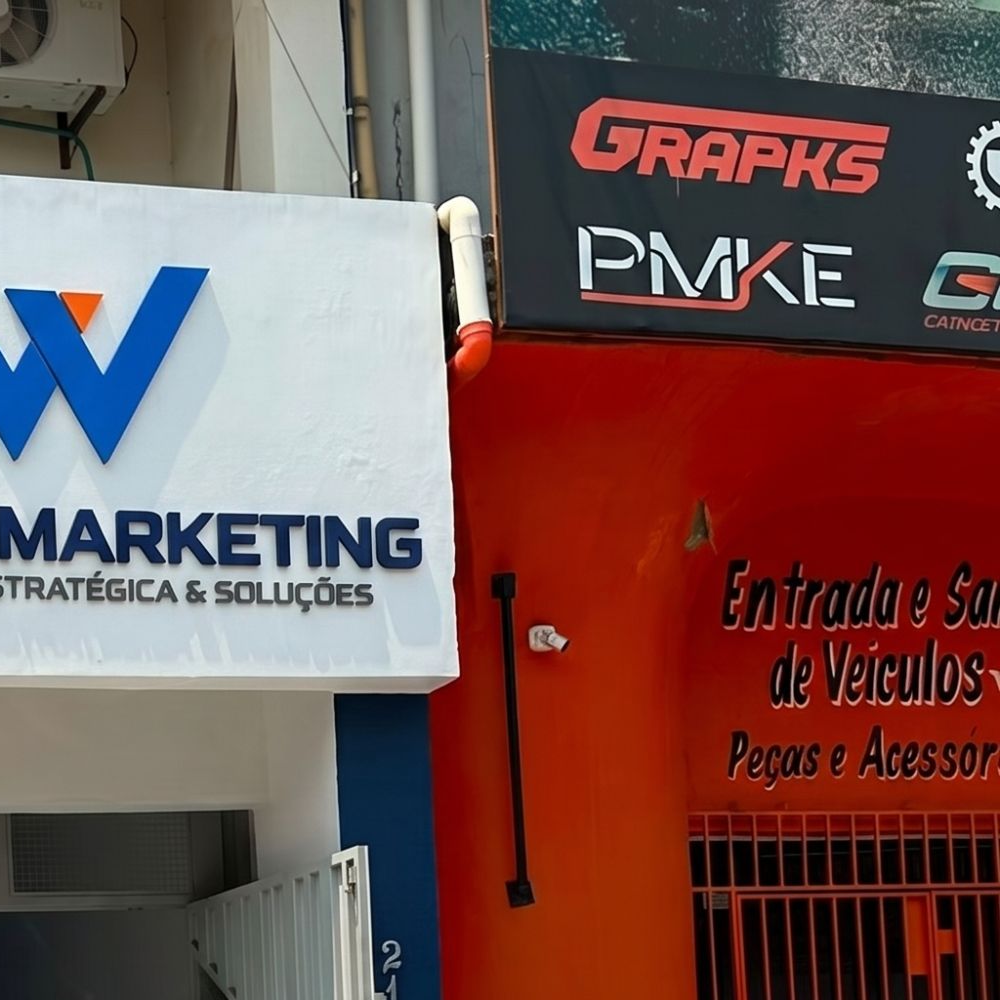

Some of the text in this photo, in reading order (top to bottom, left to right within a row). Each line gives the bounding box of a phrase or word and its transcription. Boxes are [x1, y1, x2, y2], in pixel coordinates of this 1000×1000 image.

[570, 97, 891, 194] GRAPKS
[577, 225, 857, 312] PMKE
[185, 579, 207, 605] &
[213, 576, 375, 614] SOLUÇÕES
[721, 558, 903, 631] Entrada
[909, 576, 931, 629] e
[769, 639, 815, 710] de
[727, 724, 1000, 792] Peças e Acessór
